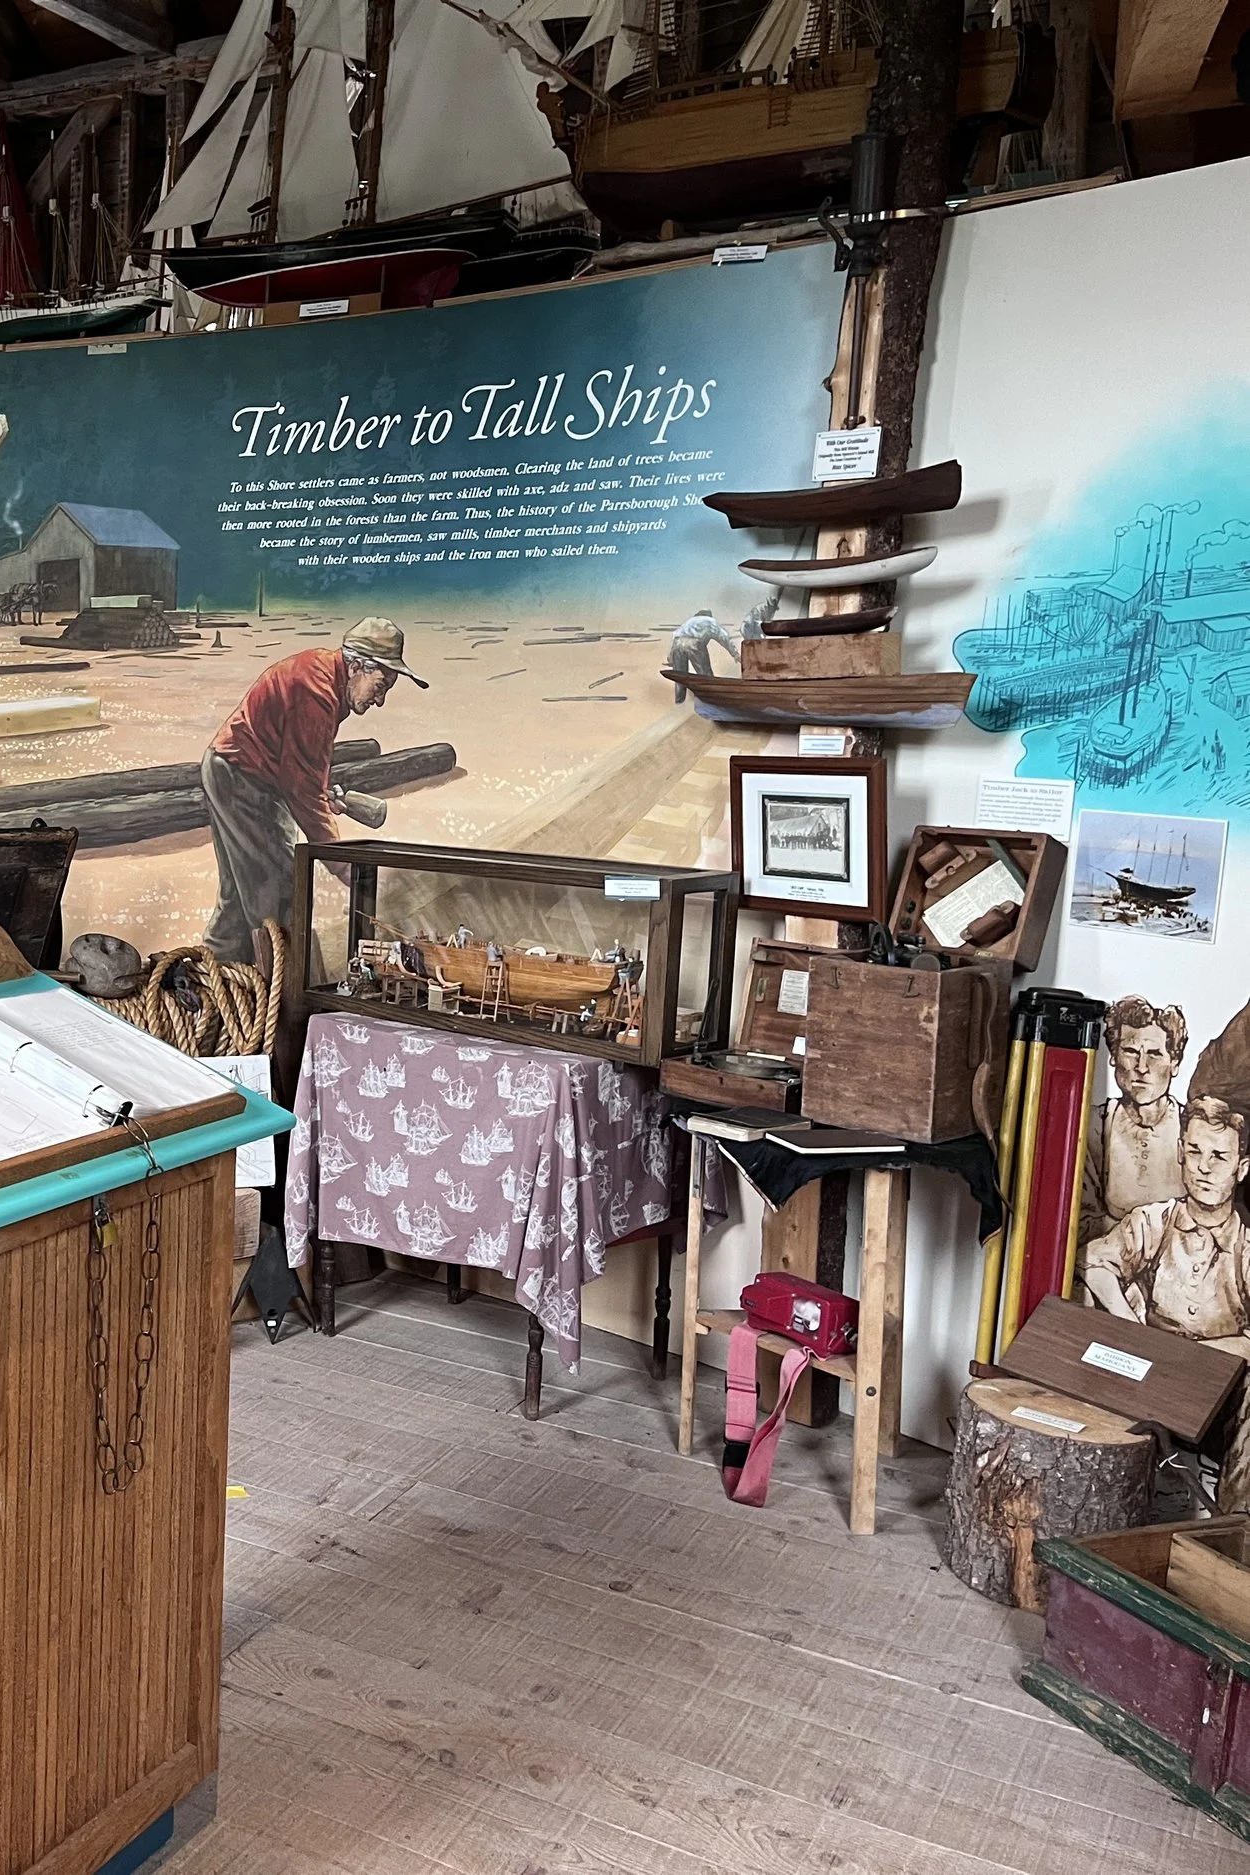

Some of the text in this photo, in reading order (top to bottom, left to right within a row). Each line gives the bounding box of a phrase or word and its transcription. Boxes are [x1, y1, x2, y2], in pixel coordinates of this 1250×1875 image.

[232, 364, 717, 458] Timber to Tall Ships
[229, 449, 714, 494] To this Shore settlers came as farmers, not woodsmen. Clearing the land of trees became
[217, 471, 727, 513] their back-breaking obsession. Soon they were skilled with axe, adz and saw. Their lives were
[221, 492, 704, 531] then more rooted in the forests than the farm. Thus, the history of the Parrsborough Sho
[259, 518, 668, 549] became the story of lumbermen, saw mills, timber merchants and shipyards
[297, 543, 620, 566] with their wooden ships and the iron men who sailed them.
